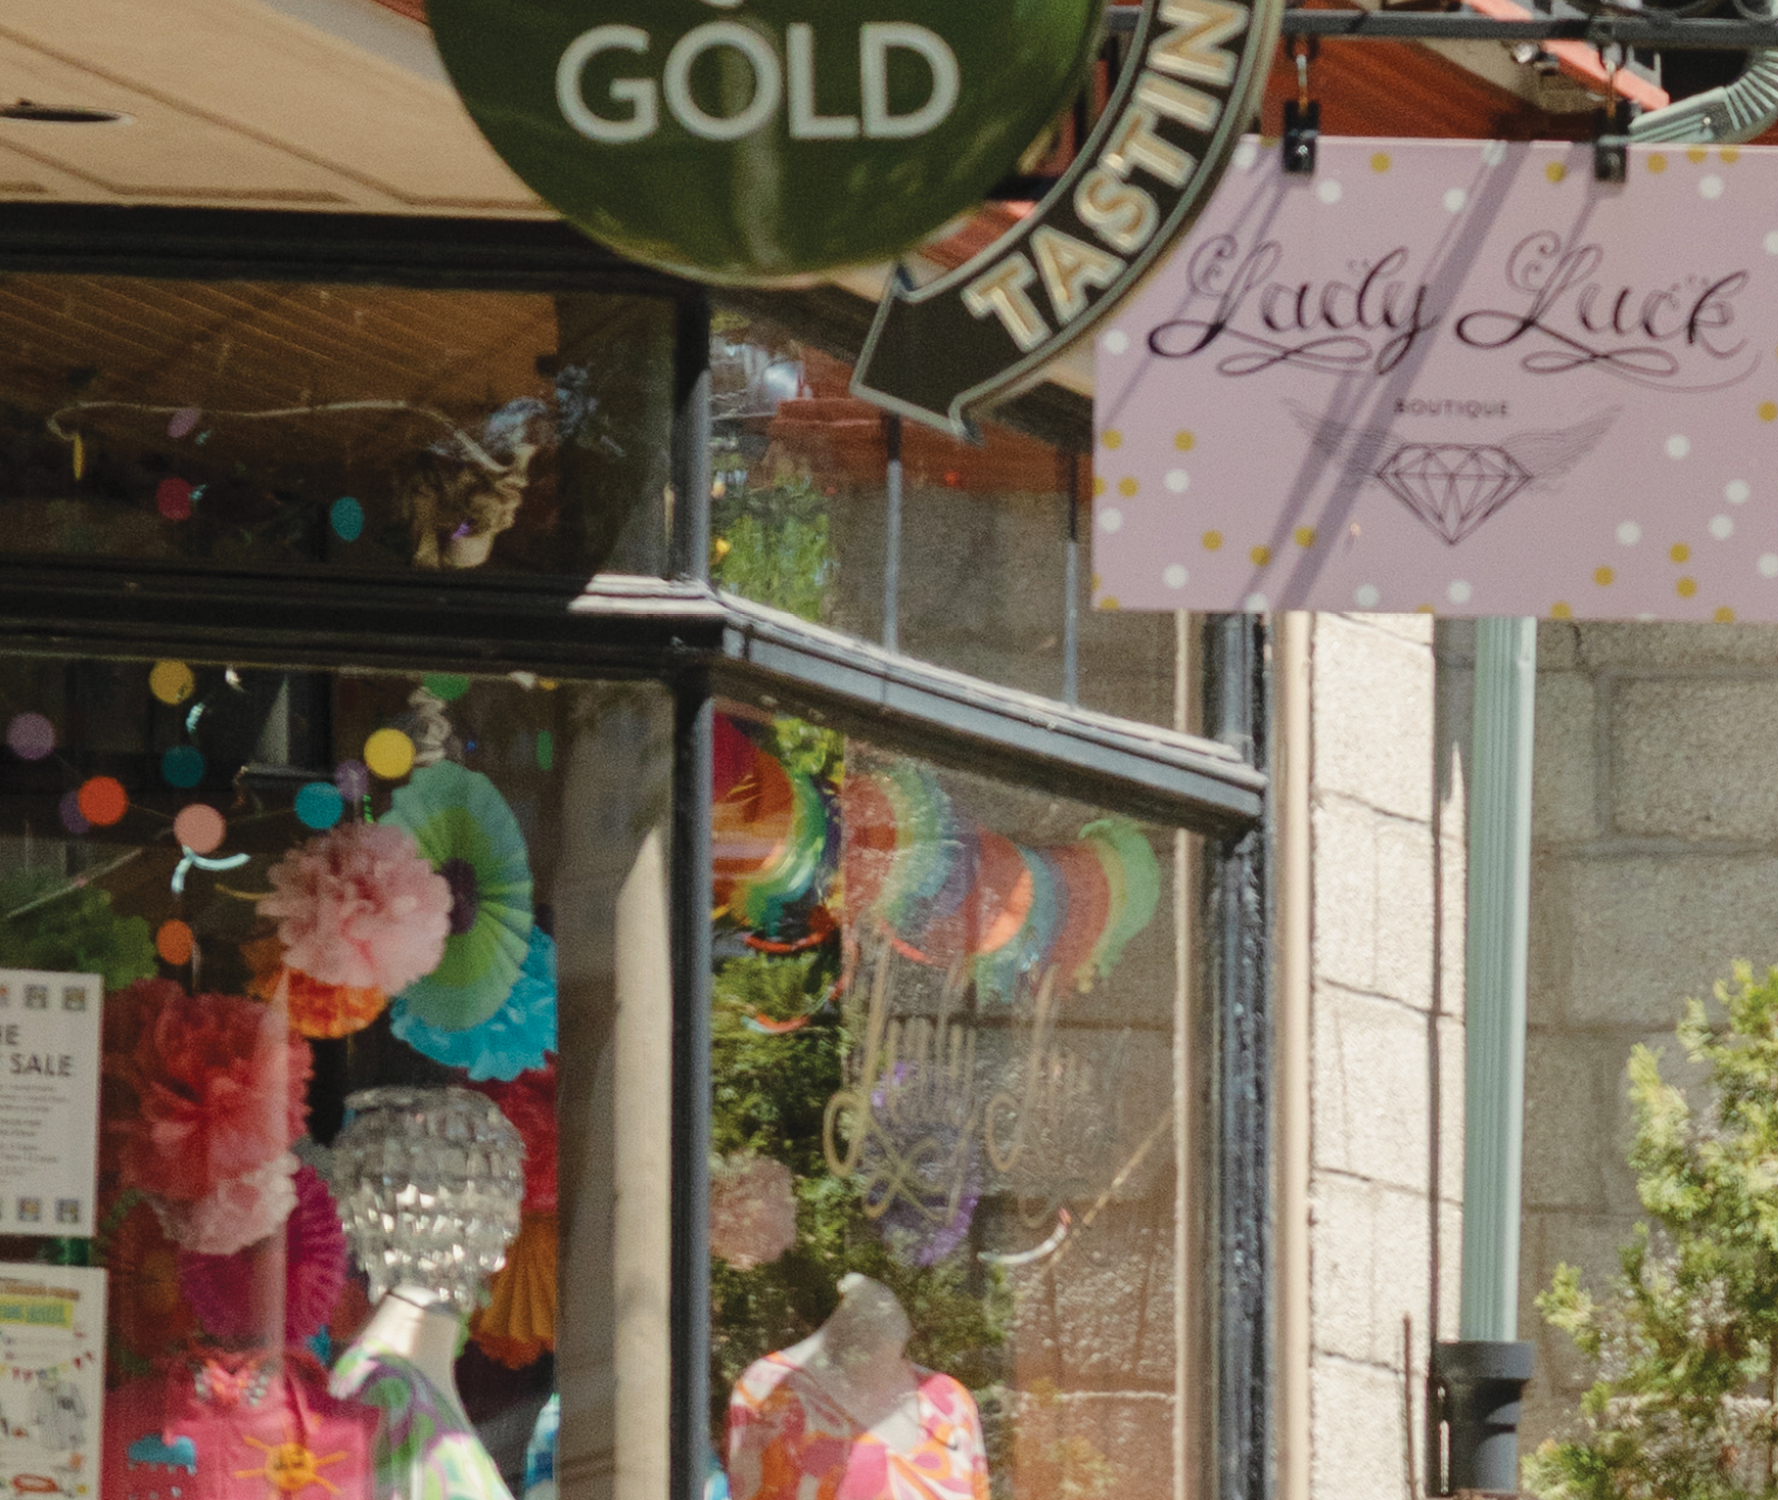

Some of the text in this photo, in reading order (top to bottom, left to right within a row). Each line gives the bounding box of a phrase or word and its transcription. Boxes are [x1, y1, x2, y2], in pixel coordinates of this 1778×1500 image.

[556, 21, 961, 143] GOLD
[1148, 230, 1761, 393] Lady Luck
[1394, 399, 1507, 417] BOUTIQUE
[10, 1053, 73, 1078] SALE
